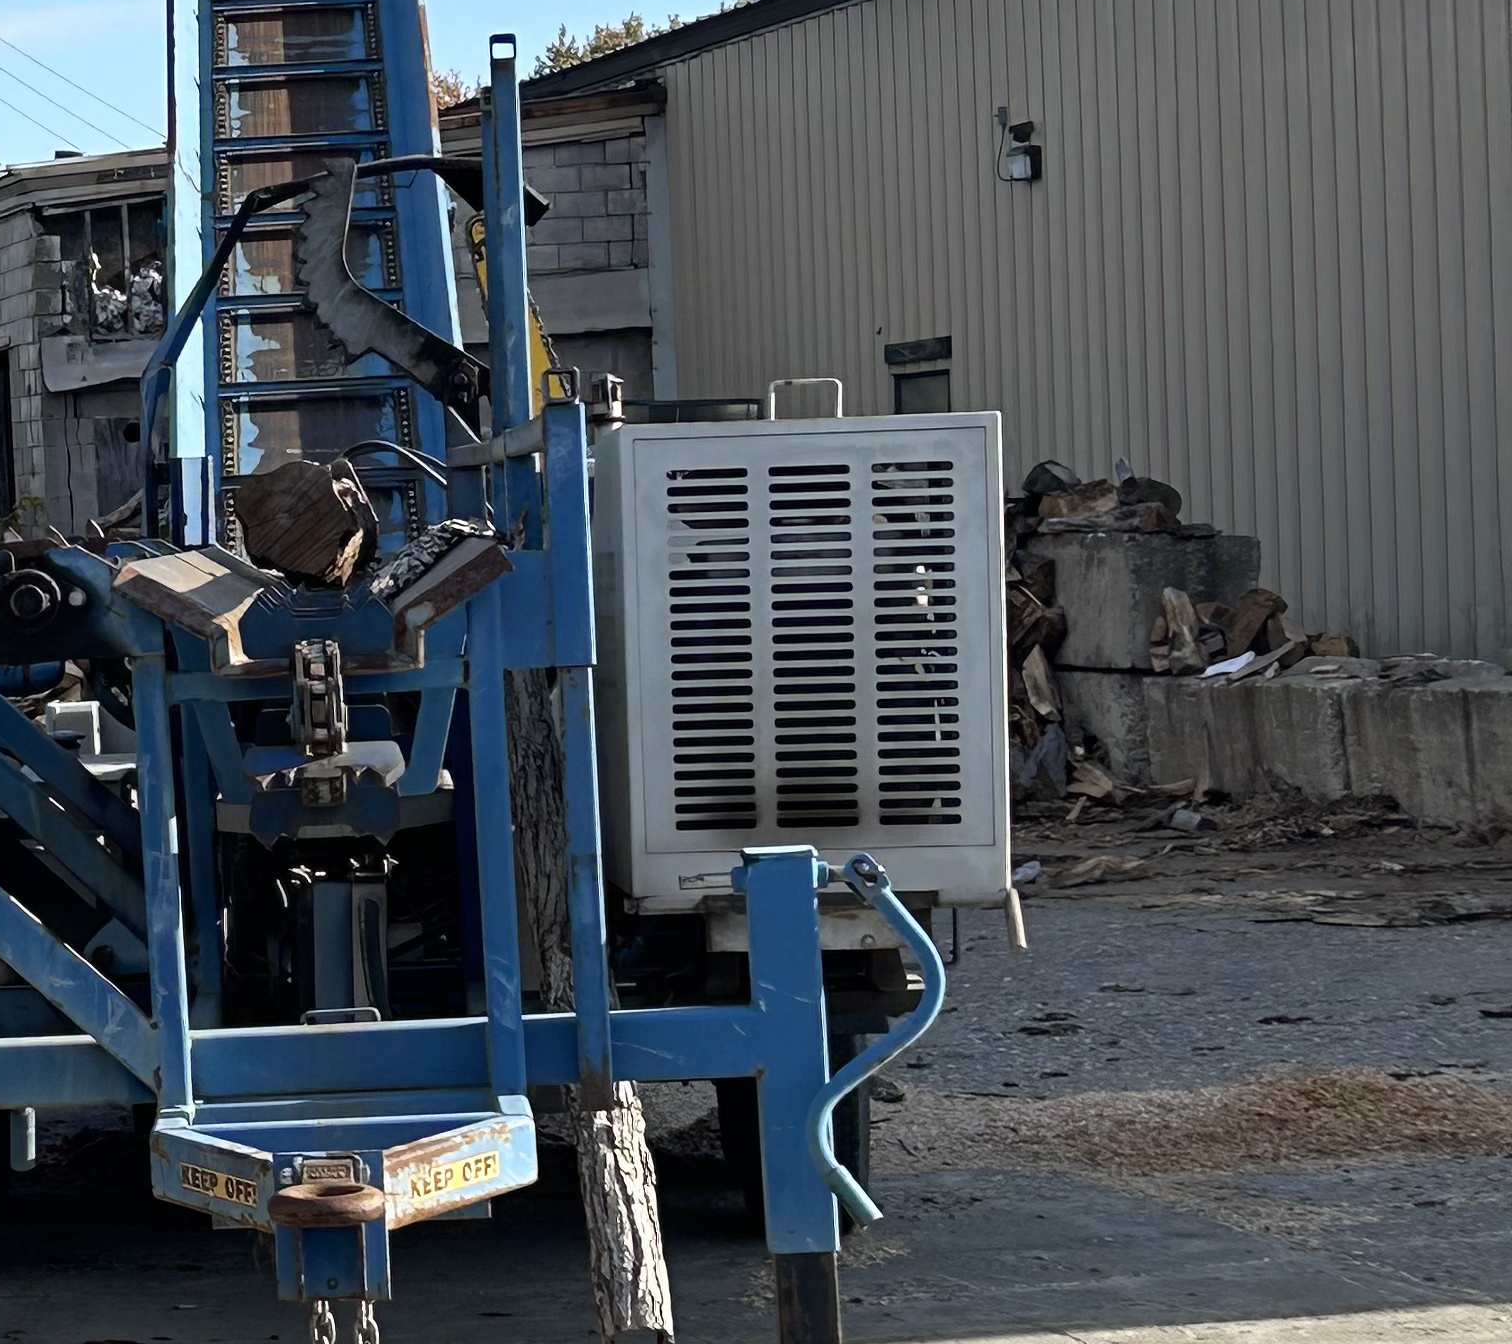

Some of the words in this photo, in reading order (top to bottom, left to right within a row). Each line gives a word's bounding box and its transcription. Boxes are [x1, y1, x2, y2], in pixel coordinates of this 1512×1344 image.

[181, 1165, 218, 1191] KEEP
[410, 1167, 454, 1198] KEEP
[462, 1154, 497, 1182] OFF!
